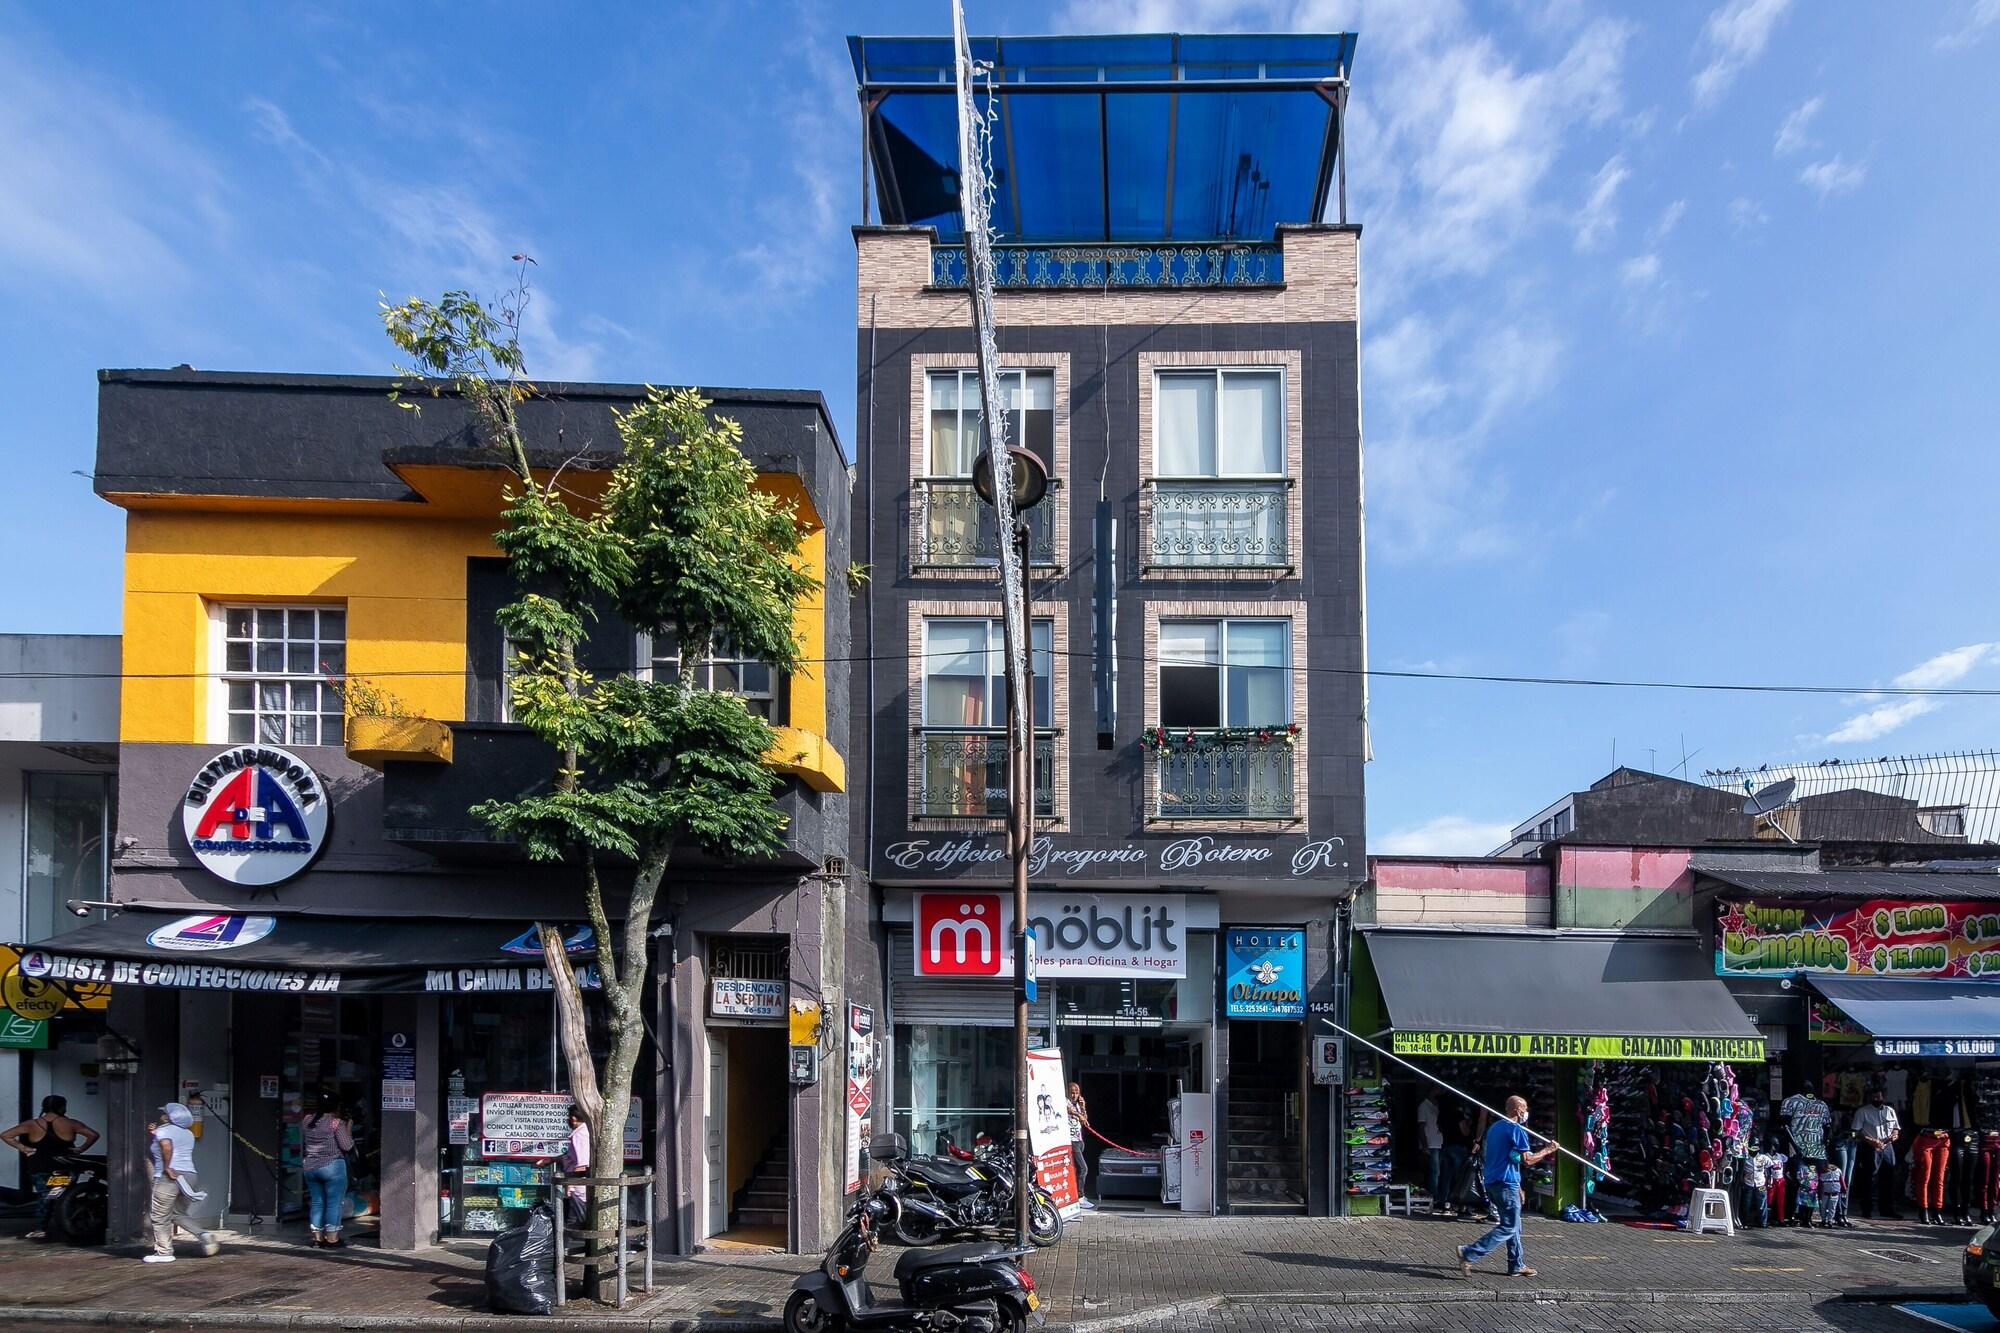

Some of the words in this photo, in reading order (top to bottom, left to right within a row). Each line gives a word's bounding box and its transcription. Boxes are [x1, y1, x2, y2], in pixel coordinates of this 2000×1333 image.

[187, 748, 320, 807] DISTRIBUIDORA
[234, 807, 265, 822] DE
[193, 839, 312, 853] CONFECCIONES
[885, 838, 1006, 871] Edificio
[1027, 836, 1148, 878] Gregorio
[1160, 836, 1272, 871] Botero
[1291, 836, 1349, 876] R.
[1744, 903, 1805, 930] Super
[1893, 906, 1946, 933] 5.000
[1235, 935, 1298, 947] HOTEL
[1059, 956, 1083, 968] para
[1087, 955, 1127, 967] Oficina
[1131, 956, 1139, 966] &
[1144, 956, 1178, 969] Hogar
[1888, 945, 1947, 970] 15.000
[50, 956, 107, 981] DIST.
[111, 961, 142, 984] DE
[143, 963, 308, 991] CONFECCIONES
[308, 973, 341, 991] AA
[425, 970, 453, 991] MI
[458, 969, 522, 991] CAMA
[526, 967, 588, 991] BEA
[717, 981, 781, 994] RESIDENCIAS
[16, 998, 58, 1014] efecty
[715, 991, 730, 1005] LA
[735, 993, 782, 1008] SEPTIMA
[725, 1005, 739, 1014] TEL.
[744, 1006, 772, 1014] 46-533
[1123, 1007, 1149, 1017] 14-56
[1310, 1003, 1335, 1013] 14-54
[1395, 1032, 1420, 1043] CALLE
[1422, 1033, 1432, 1044] 14
[1436, 1033, 1521, 1054] CALZADO
[1529, 1036, 1590, 1055] ARBEY
[1410, 1044, 1432, 1053] 14-48
[1621, 1037, 1681, 1057] CALZADO
[1691, 1039, 1760, 1059] MARICELA
[1885, 1040, 1920, 1054] 5.000
[1956, 1039, 1995, 1054] 10.000
